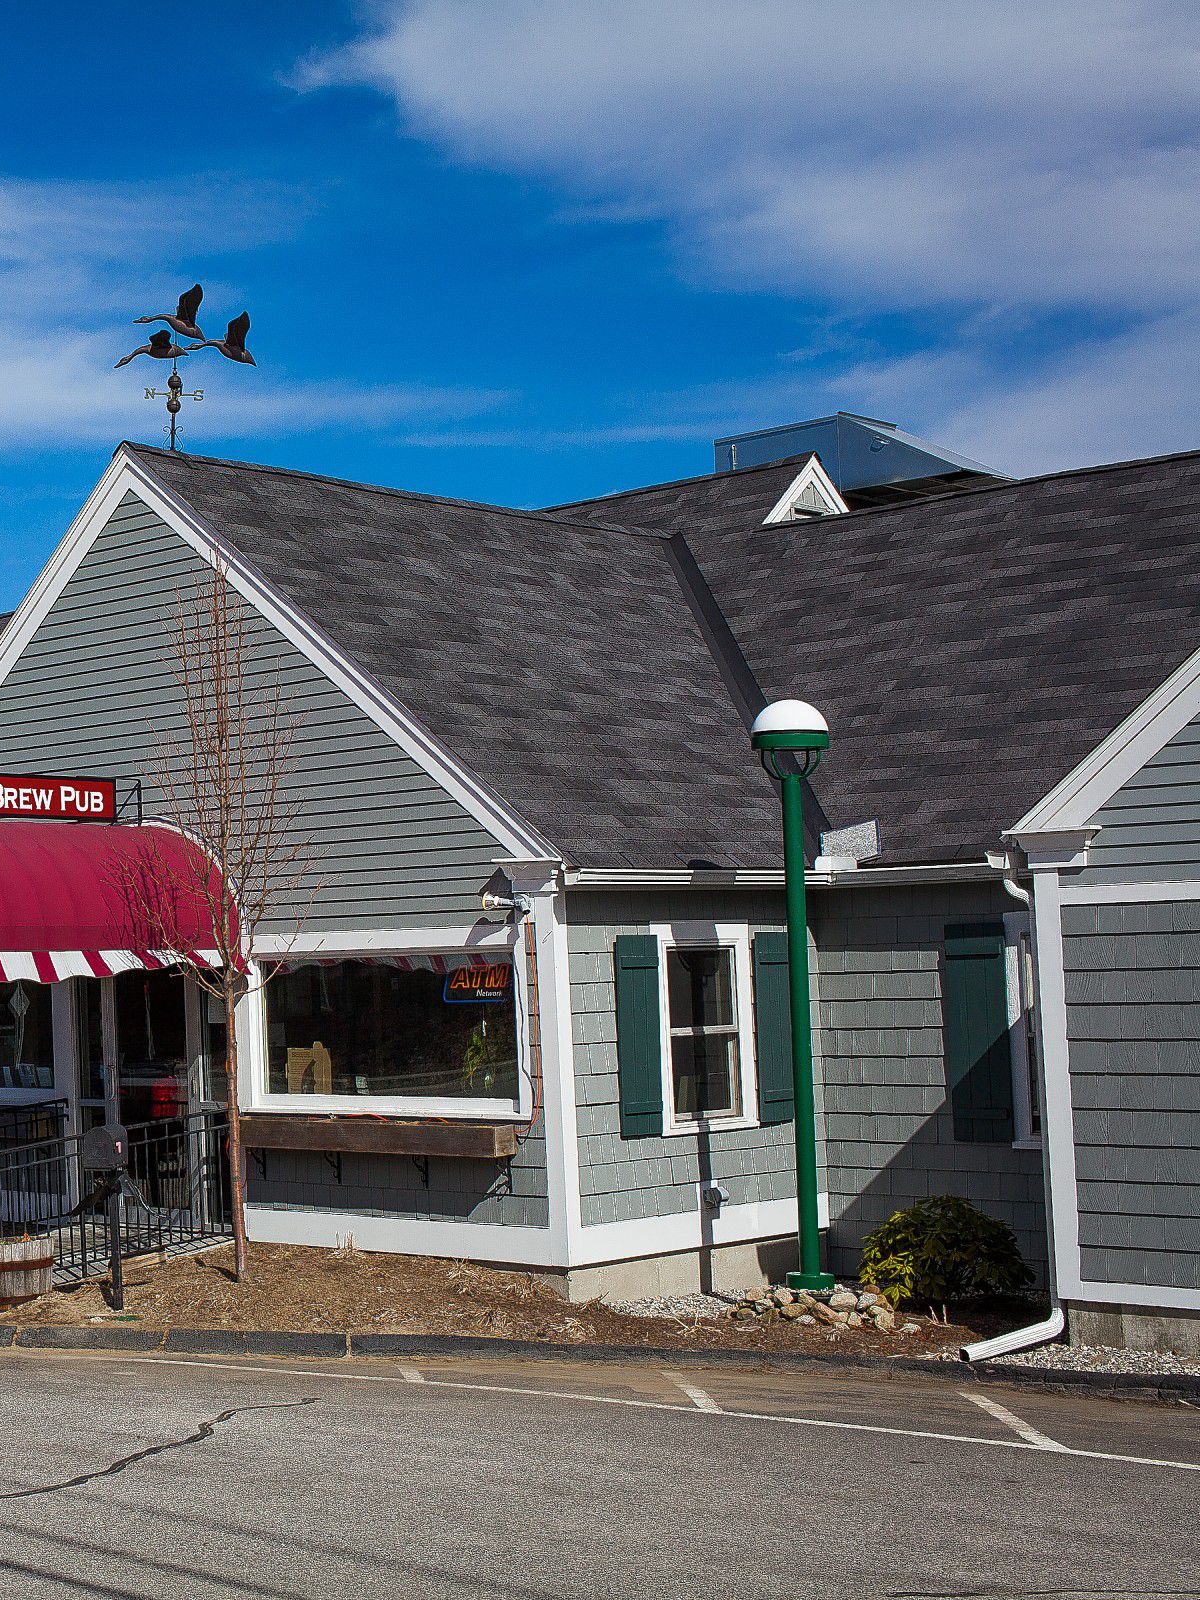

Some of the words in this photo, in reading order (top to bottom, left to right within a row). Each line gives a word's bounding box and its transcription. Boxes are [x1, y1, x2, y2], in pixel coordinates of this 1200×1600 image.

[144, 387, 156, 400] N
[194, 389, 204, 401] S
[60, 785, 104, 812] PUB
[450, 963, 509, 989] ATM
